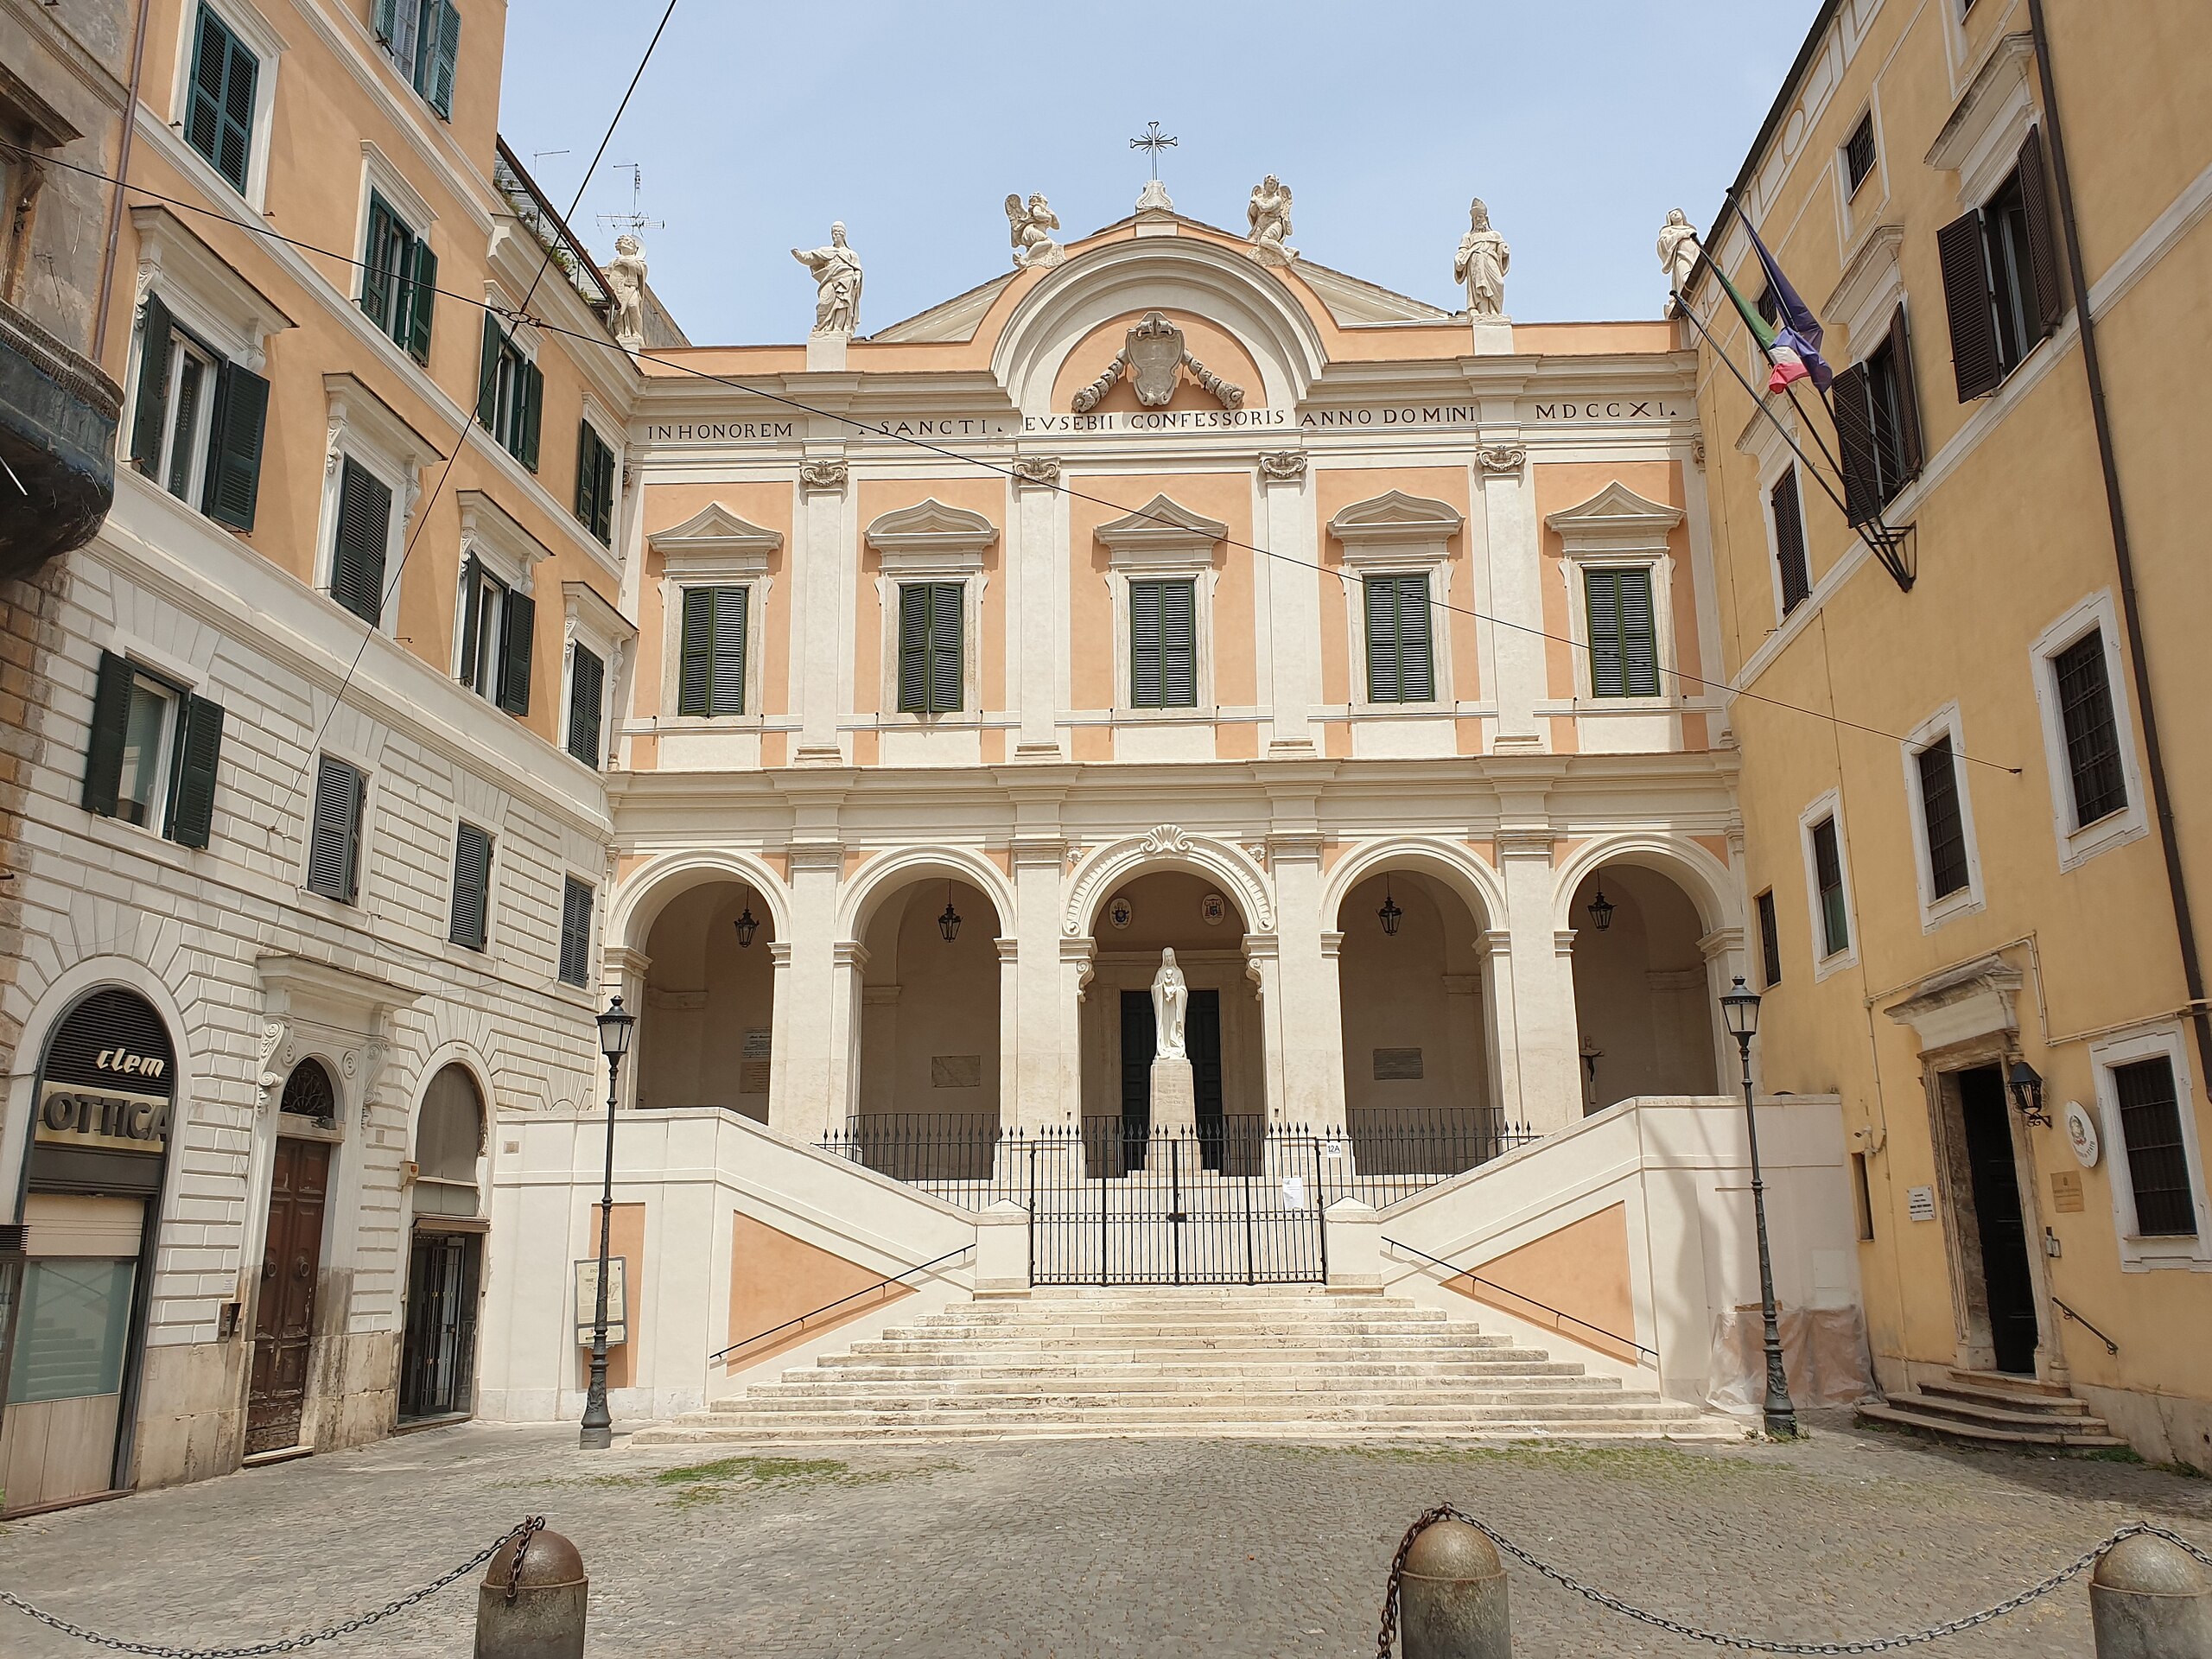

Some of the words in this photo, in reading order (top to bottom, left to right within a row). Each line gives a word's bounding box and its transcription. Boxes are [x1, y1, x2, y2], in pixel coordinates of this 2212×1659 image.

[1025, 415, 1114, 431] EVSEBII
[1130, 410, 1285, 429] CONFESSORIS
[1300, 410, 1372, 426] ANNO
[1382, 405, 1475, 423] DOMINI
[95, 1047, 165, 1078] clem
[44, 1091, 170, 1142] OTTICA
[1327, 1144, 1340, 1153] 12A
